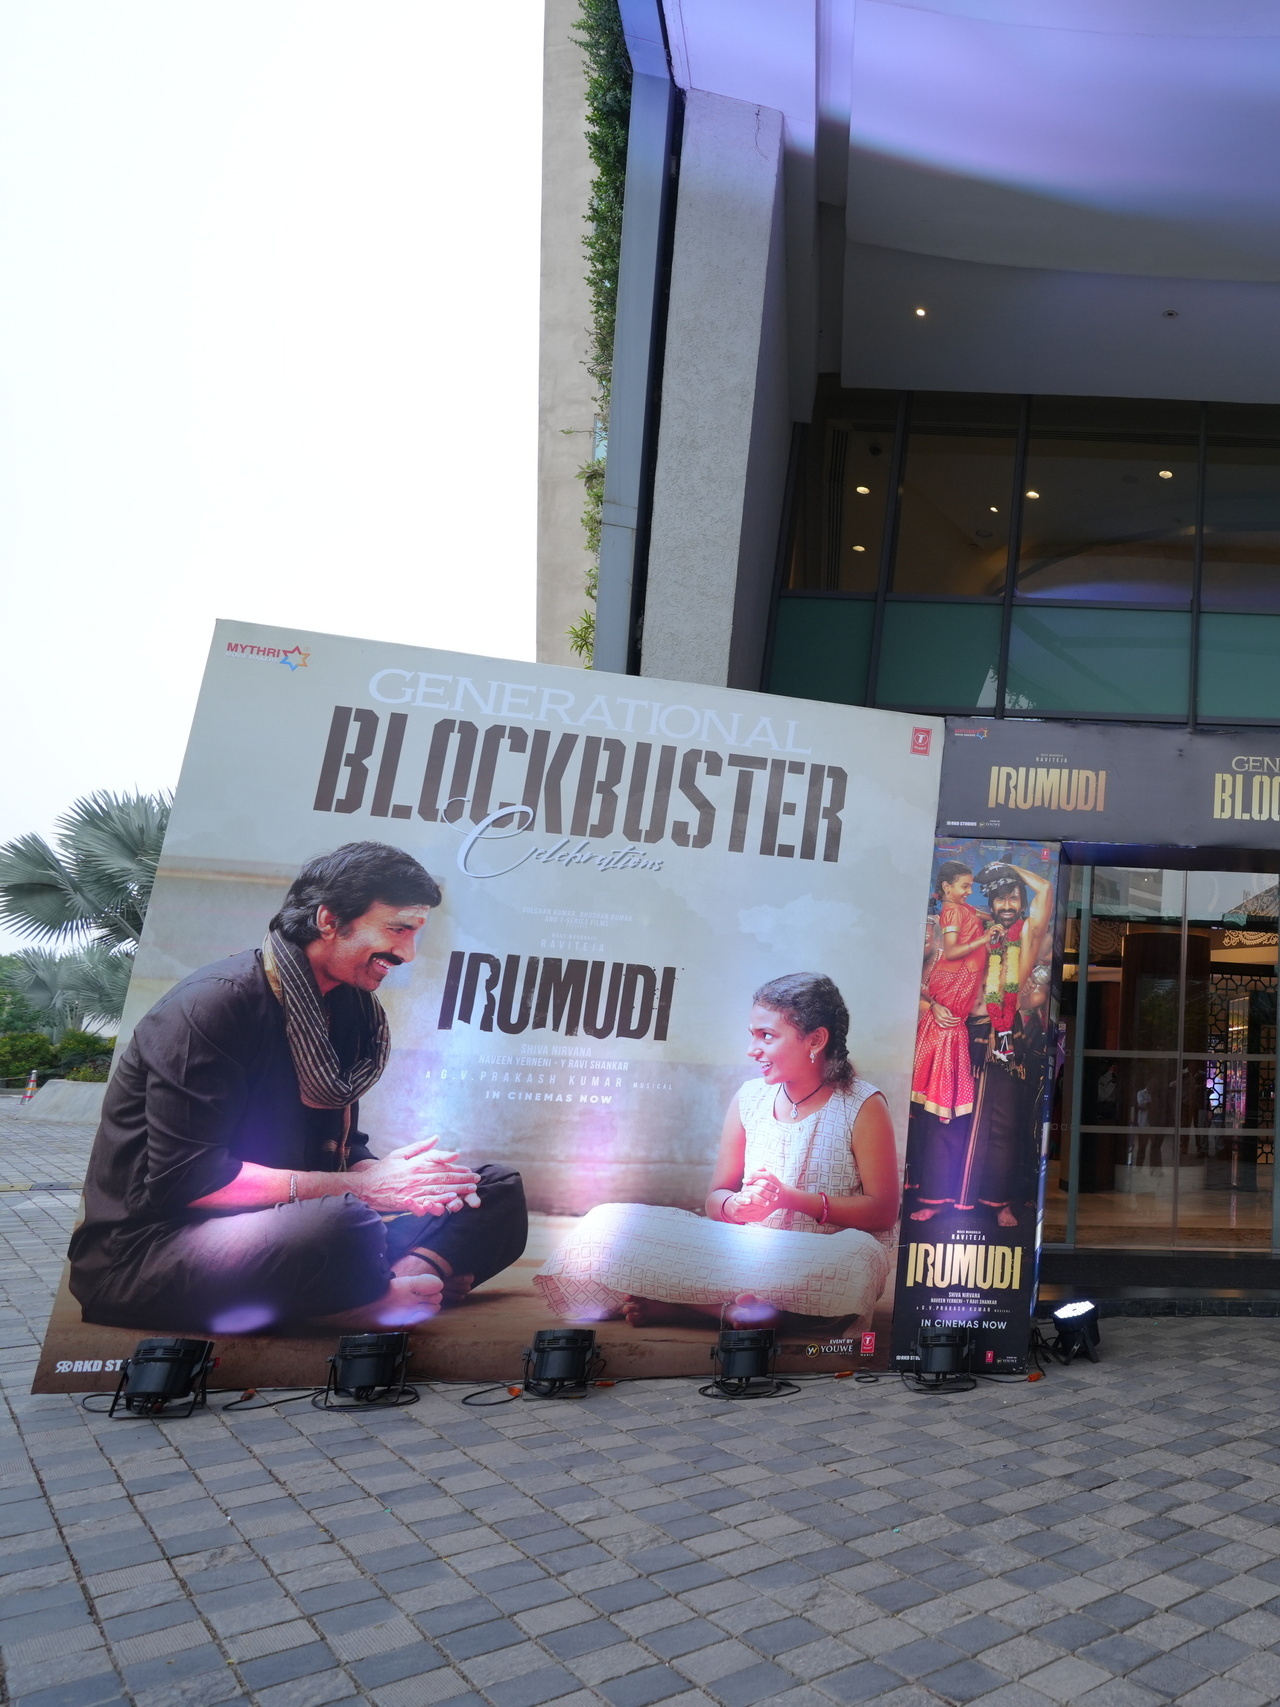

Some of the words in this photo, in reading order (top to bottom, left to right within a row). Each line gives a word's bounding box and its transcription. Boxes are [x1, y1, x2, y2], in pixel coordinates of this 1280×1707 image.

[227, 642, 281, 658] MYTHRI
[367, 668, 812, 755] GENERATIONAL
[313, 705, 848, 863] BLOCKBUSTER
[988, 766, 1106, 811] IRUMUDI
[442, 797, 666, 878] Celebrations
[544, 915, 558, 923] AND
[560, 916, 589, 926] T-SERIES
[590, 918, 609, 927] FILMS
[541, 939, 605, 952] RAVITEJA
[437, 951, 677, 1041] IRUMUDI
[521, 1043, 549, 1056] SHIVA
[552, 1045, 592, 1058] NIRVANA
[479, 1055, 513, 1065] NAVEEN
[515, 1056, 552, 1067] YERNENI
[561, 1059, 567, 1068] Y
[568, 1059, 588, 1069] RAVI
[590, 1060, 629, 1071] SHANKAR
[425, 1071, 431, 1079] A
[569, 1075, 622, 1088] KUMAR
[633, 1082, 673, 1090] MUSICAL
[485, 1090, 500, 1100] IN
[508, 1092, 573, 1102] CINEMAS
[580, 1095, 613, 1104] NOW
[951, 1233, 986, 1241] RAVITEJA
[906, 1242, 1022, 1290] IRUMUDI
[921, 1319, 931, 1327] IN
[934, 1319, 979, 1329] CINEMAS
[982, 1320, 1007, 1330] NOW
[821, 1345, 853, 1353] YOUWE
[73, 1360, 103, 1372] RKD
